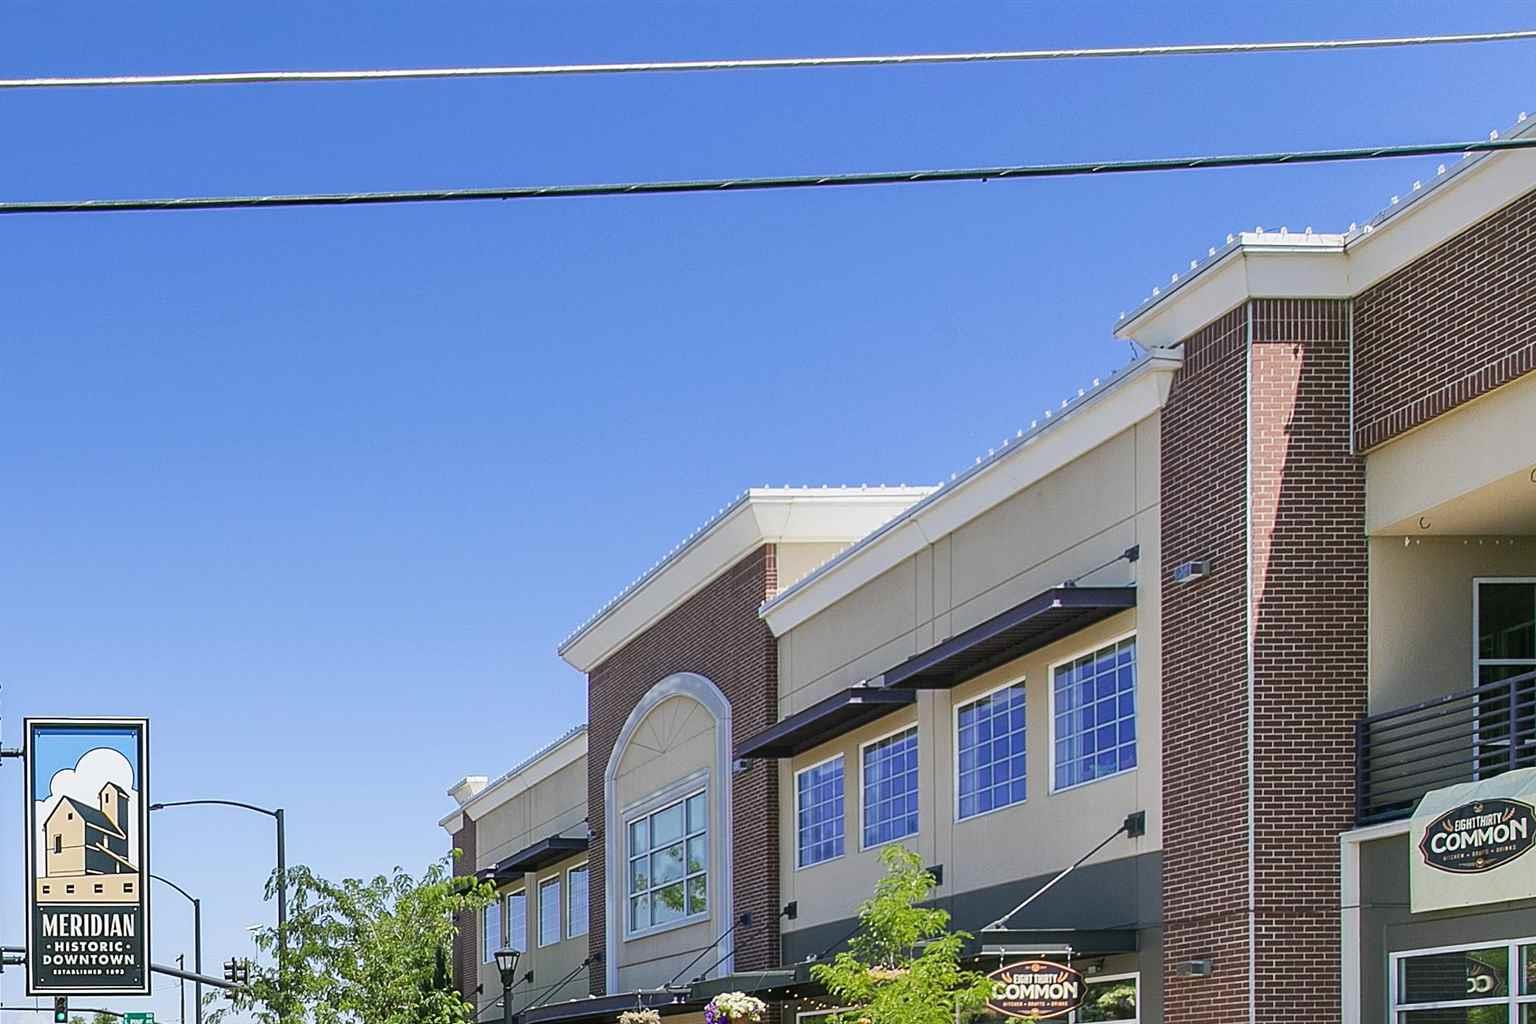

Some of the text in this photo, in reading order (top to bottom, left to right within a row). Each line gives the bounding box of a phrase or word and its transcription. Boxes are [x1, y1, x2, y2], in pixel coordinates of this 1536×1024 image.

[1431, 817, 1527, 854] COMMON
[42, 913, 135, 937] MERIDIAN
[54, 941, 123, 952] HISTORIC
[42, 954, 135, 965] DOWNTOWN
[992, 981, 1078, 1000] COMMON
